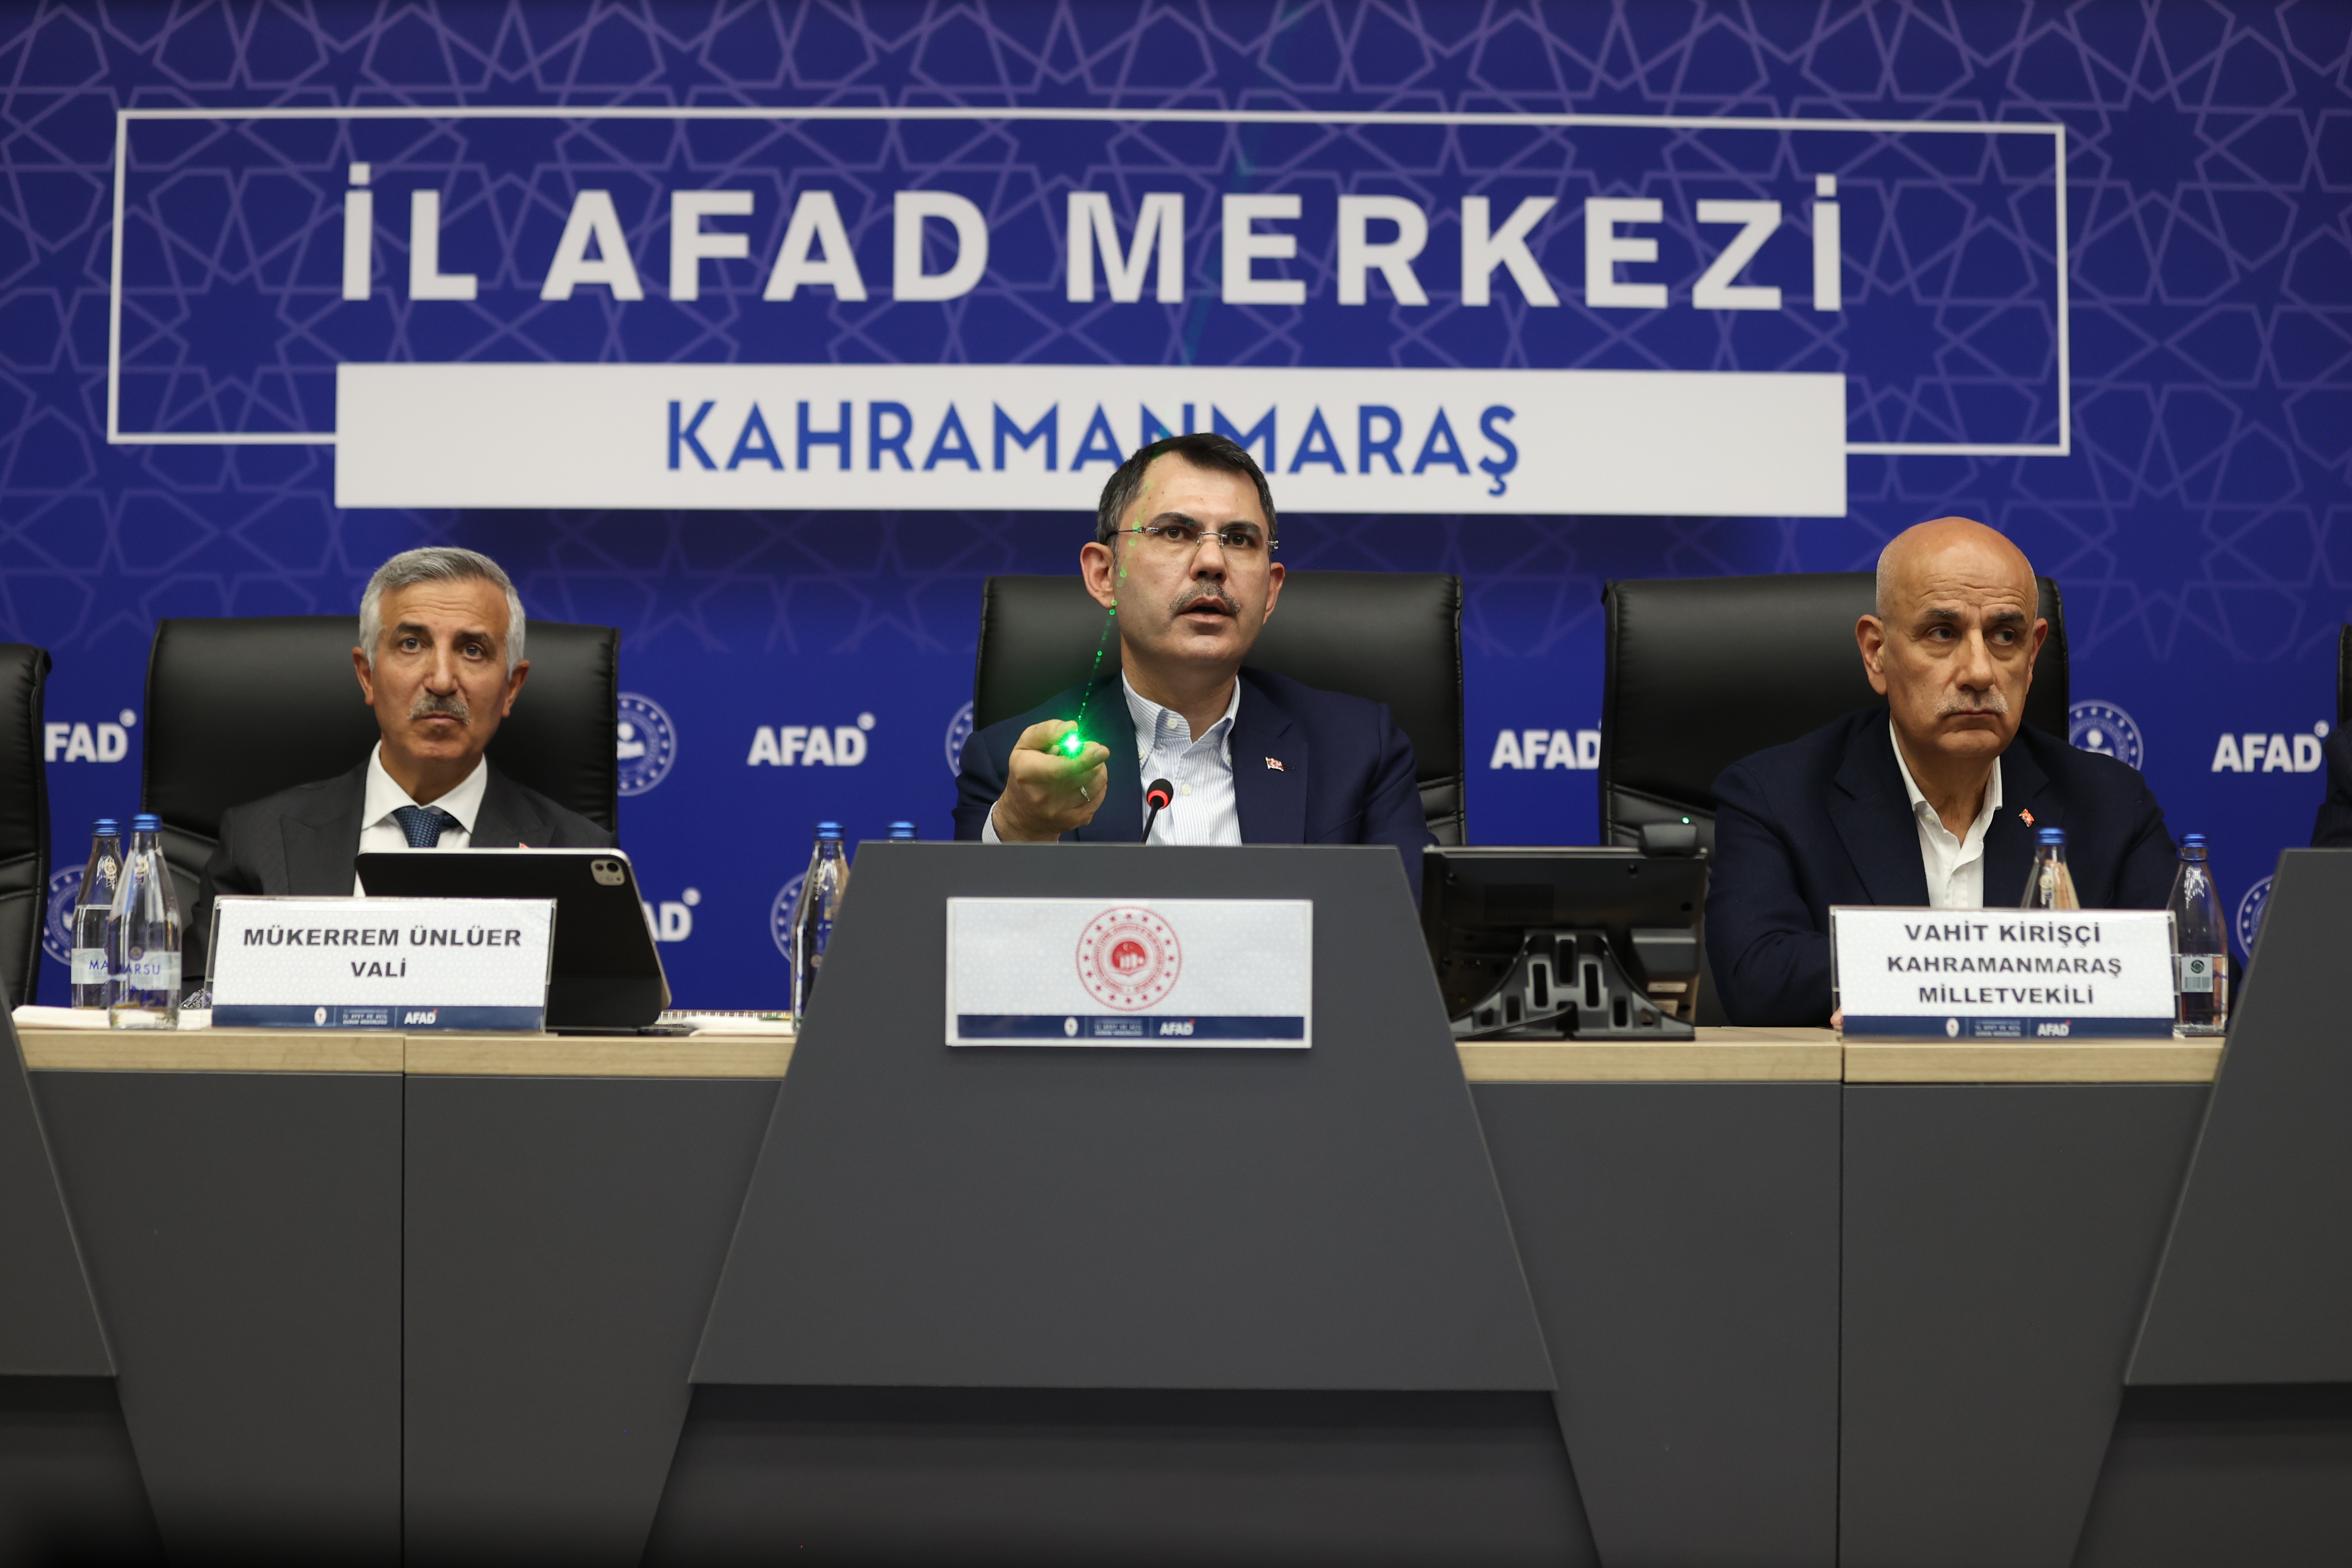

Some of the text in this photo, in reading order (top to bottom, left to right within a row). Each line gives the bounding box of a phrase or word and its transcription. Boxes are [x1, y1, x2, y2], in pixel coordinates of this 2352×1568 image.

[342, 162, 1842, 312] İL AFAD MERKEZİ
[44, 723, 129, 763] FAD
[747, 726, 867, 766] AFAD
[1490, 730, 1601, 769] AFAD
[2212, 734, 2322, 772] AFAD
[243, 925, 521, 946] MÜKERREM ÜNLÜER
[1905, 920, 2101, 948] VAHİT KİRİŞÇİ
[351, 958, 406, 977] VALİ
[1887, 957, 2122, 979] KAHRAMANMARAŞ
[1919, 983, 2093, 1004] MİLLETVEKİLİ
[404, 1012, 436, 1024] AFAD
[1160, 1022, 1194, 1035] AFAD
[2037, 1023, 2070, 1036] AFAD
